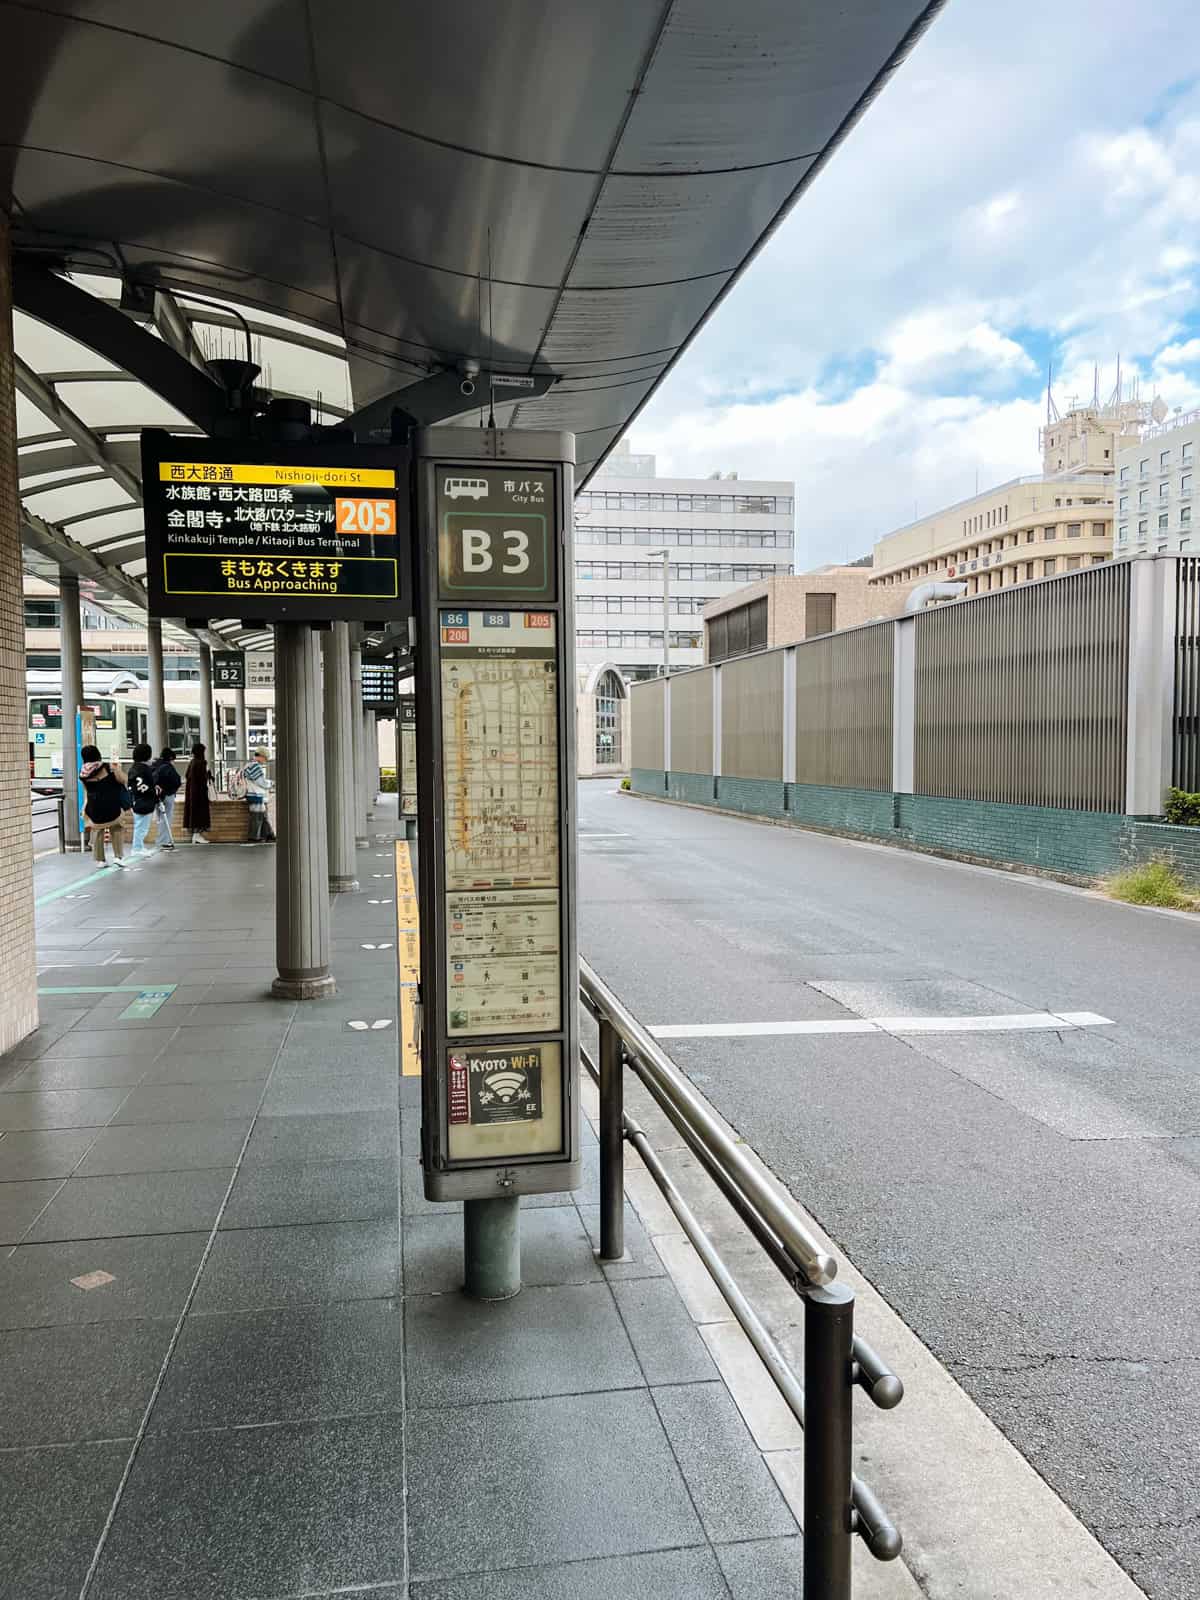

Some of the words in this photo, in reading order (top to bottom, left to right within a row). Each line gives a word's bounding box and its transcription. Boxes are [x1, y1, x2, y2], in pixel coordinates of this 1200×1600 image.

[170, 464, 234, 481] 西大路通
[275, 469, 347, 483] Nishioji-dori
[350, 472, 361, 483] St
[503, 480, 545, 493] 市バス
[165, 486, 293, 503] 水族館・西大路四条
[512, 494, 528, 505] City
[530, 495, 545, 503] Bus
[341, 501, 391, 531] 205
[167, 534, 216, 546] Kinkakuji
[218, 534, 254, 546] Temple
[262, 535, 295, 547] Kitaoji
[297, 536, 316, 547] Bus
[318, 537, 360, 548] Terminal
[220, 559, 342, 578] まもなくきます
[227, 577, 250, 589] Bus
[254, 578, 337, 592] Approaching
[447, 614, 463, 625] 86
[489, 614, 504, 625] 88
[530, 615, 550, 626] 205
[448, 629, 467, 642] 208
[221, 669, 239, 680] B2
